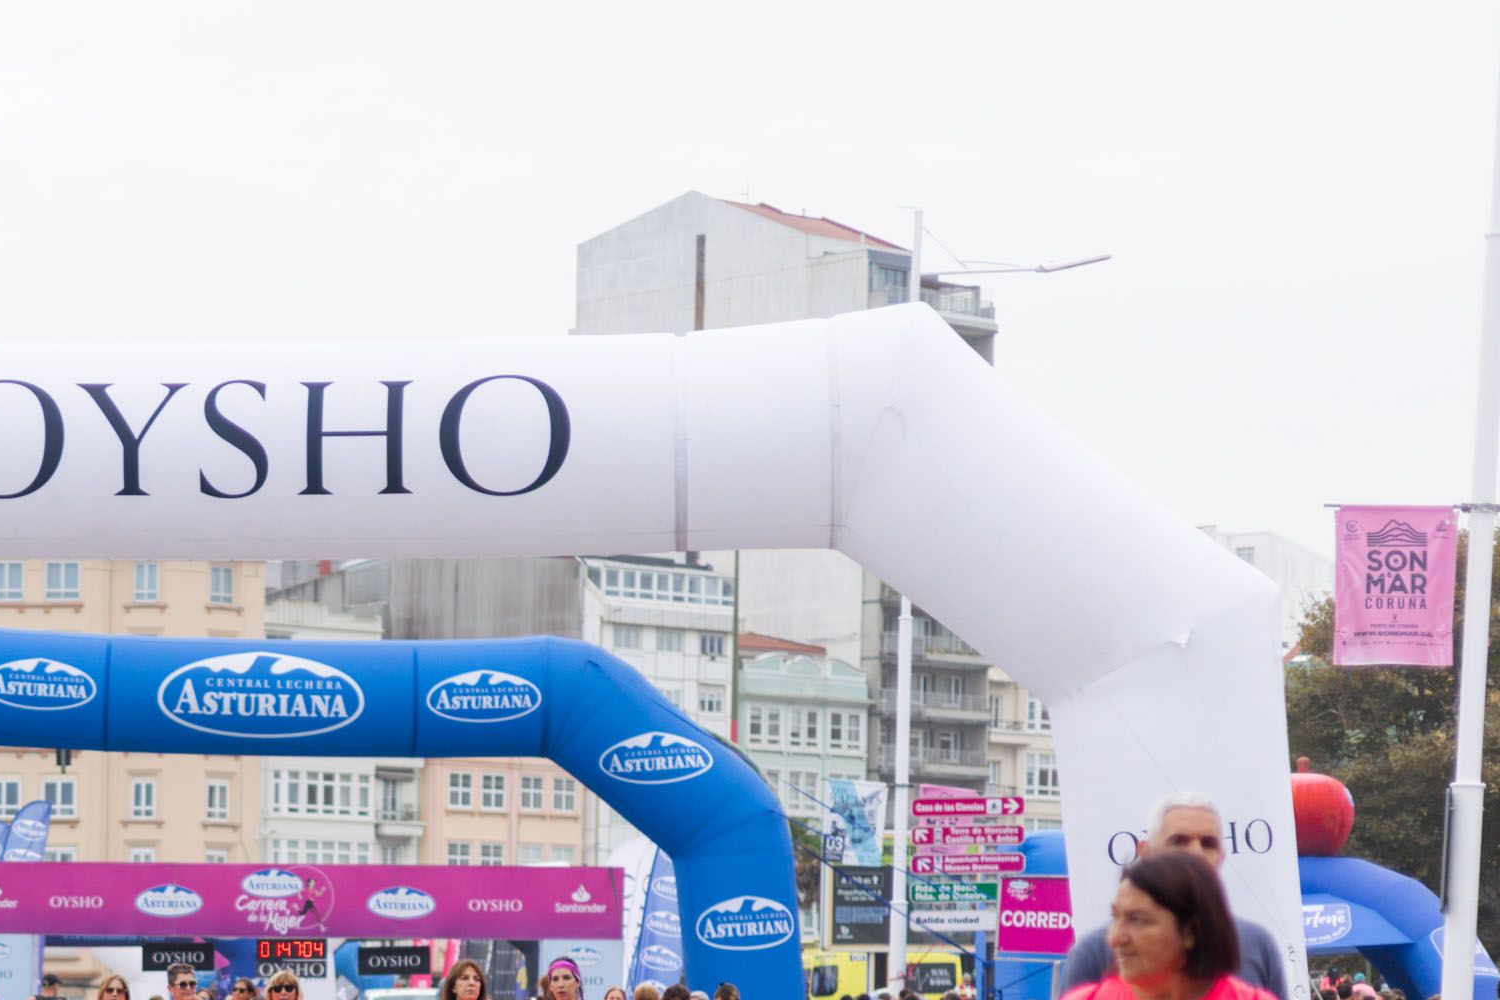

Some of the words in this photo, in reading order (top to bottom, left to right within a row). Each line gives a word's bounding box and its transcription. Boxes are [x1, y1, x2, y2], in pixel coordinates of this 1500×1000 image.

[1367, 550, 1428, 572] SON
[1366, 573, 1428, 595] MAR
[206, 677, 271, 688] CENTRAL
[276, 680, 343, 690] LECHERA
[173, 678, 348, 718] ASTURIANA
[435, 689, 533, 710] ASTURIANA
[609, 753, 706, 773] ASTURIANA
[916, 803, 933, 812] Casa
[934, 803, 943, 811] de
[826, 837, 843, 851] 03
[49, 896, 103, 909] OYSHO
[142, 897, 198, 908] ASTURIANA
[236, 894, 288, 911] Carrera
[373, 898, 430, 911] ASTURIANA
[468, 898, 523, 912] OYSHO
[554, 901, 607, 913] Santander
[264, 910, 306, 935] Mujer
[704, 918, 789, 939] ASTURIANA
[153, 951, 205, 963] OYSHO
[368, 955, 421, 968] OYSHO
[258, 962, 325, 977] OYSHO
